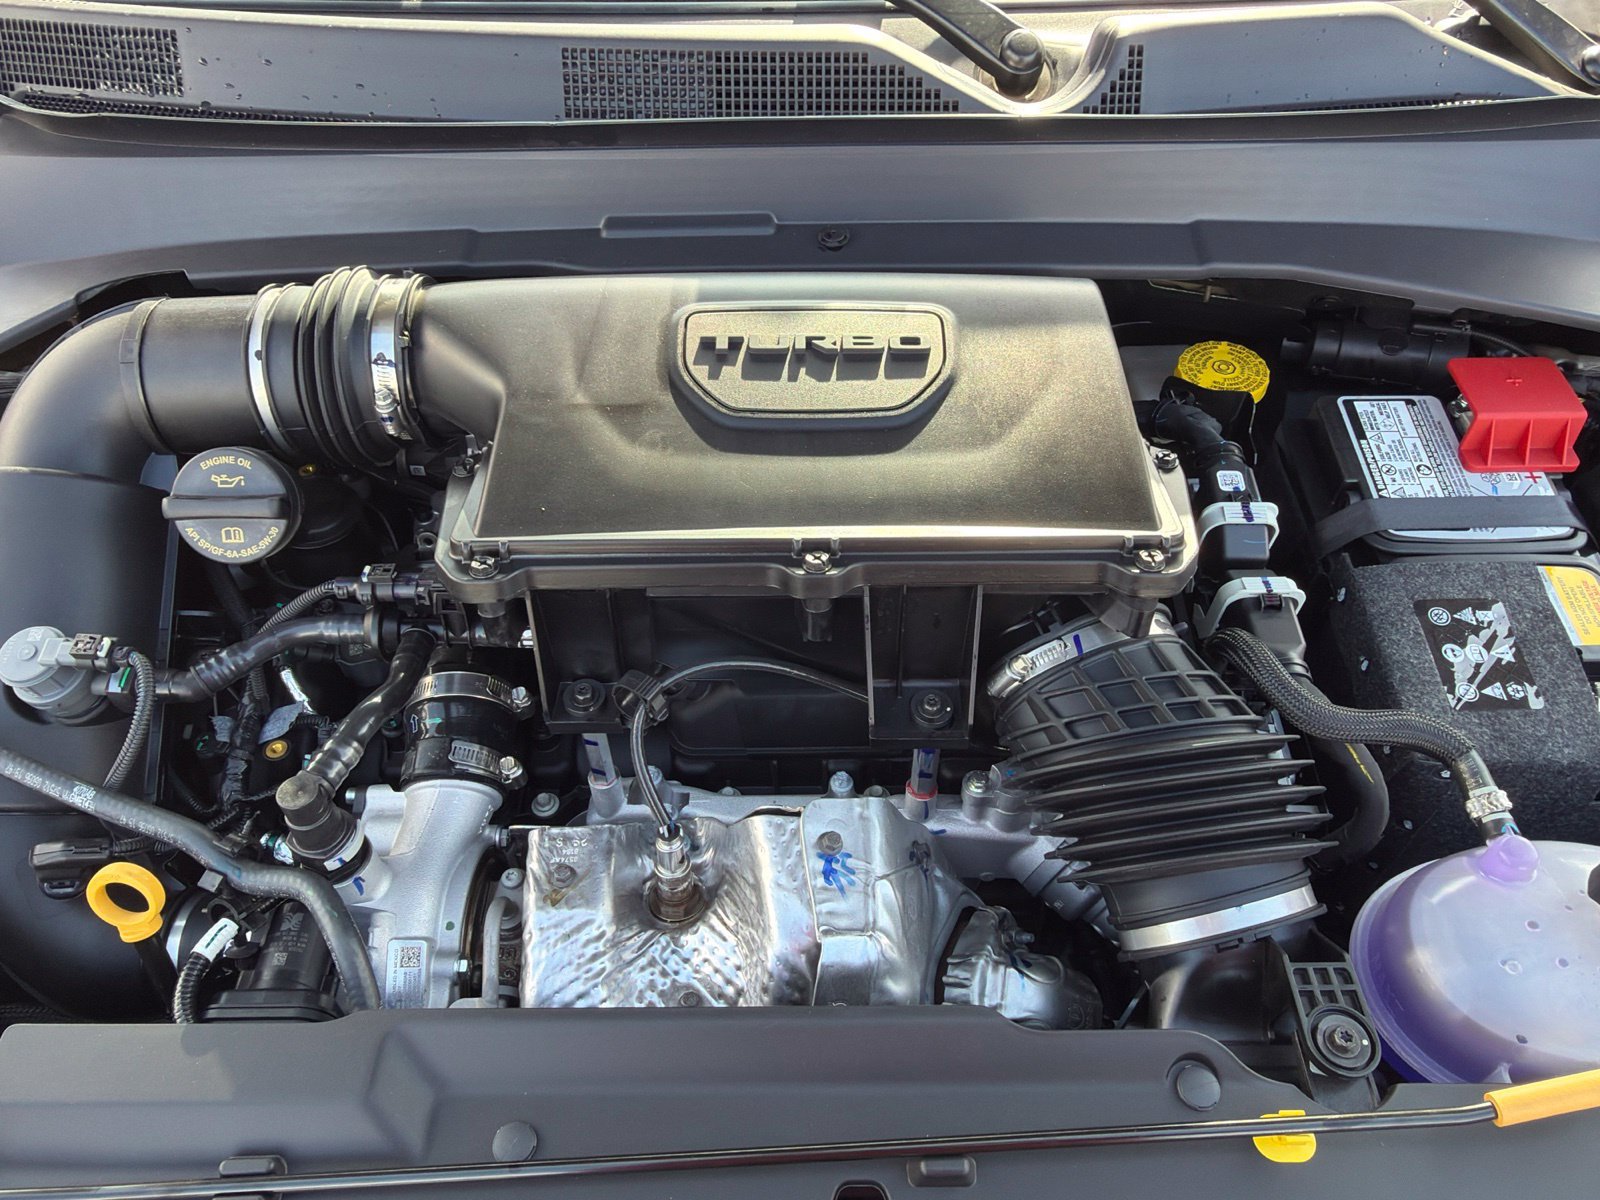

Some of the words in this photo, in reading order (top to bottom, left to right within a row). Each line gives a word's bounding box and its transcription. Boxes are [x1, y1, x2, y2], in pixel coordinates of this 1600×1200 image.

[696, 334, 932, 360] TURBO
[200, 456, 236, 470] ENGINE
[237, 458, 252, 470] OIL
[1359, 439, 1385, 489] DANGER/POISON
[185, 527, 200, 541] API
